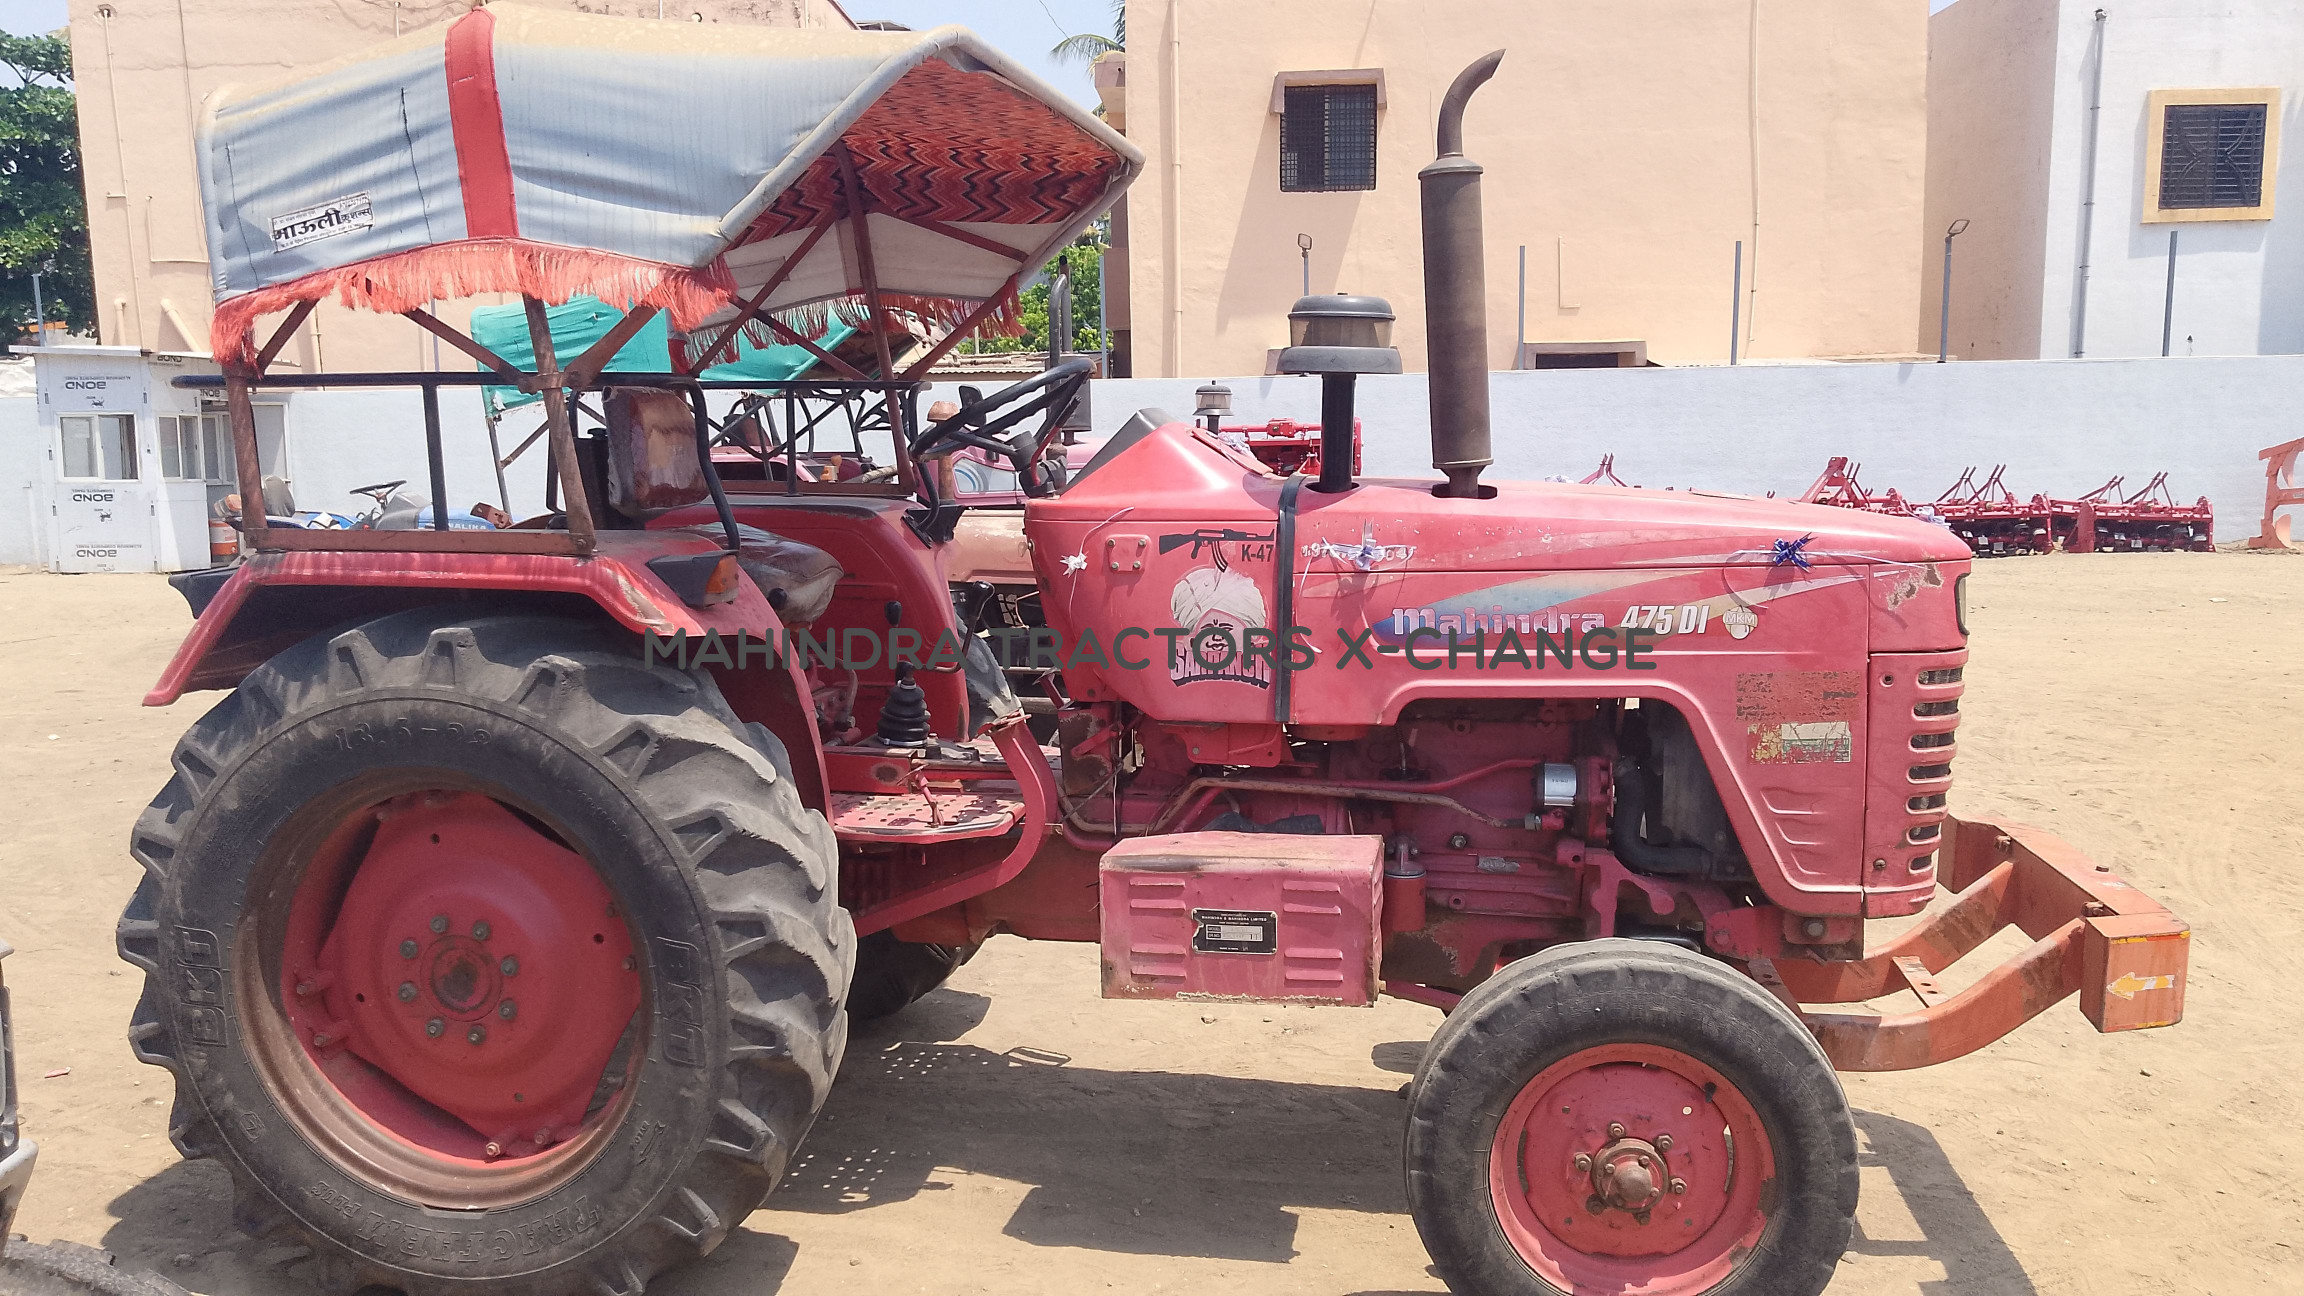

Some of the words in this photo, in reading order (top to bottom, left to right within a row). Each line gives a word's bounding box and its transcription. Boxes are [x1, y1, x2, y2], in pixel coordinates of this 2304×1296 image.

[65, 381, 107, 390] BOND
[448, 522, 487, 530] NALIKA
[76, 549, 118, 557] BOND
[1241, 543, 1274, 563] K-47
[1621, 605, 1673, 635] 475
[1678, 605, 1710, 635] DI
[1725, 610, 1755, 625] MKM
